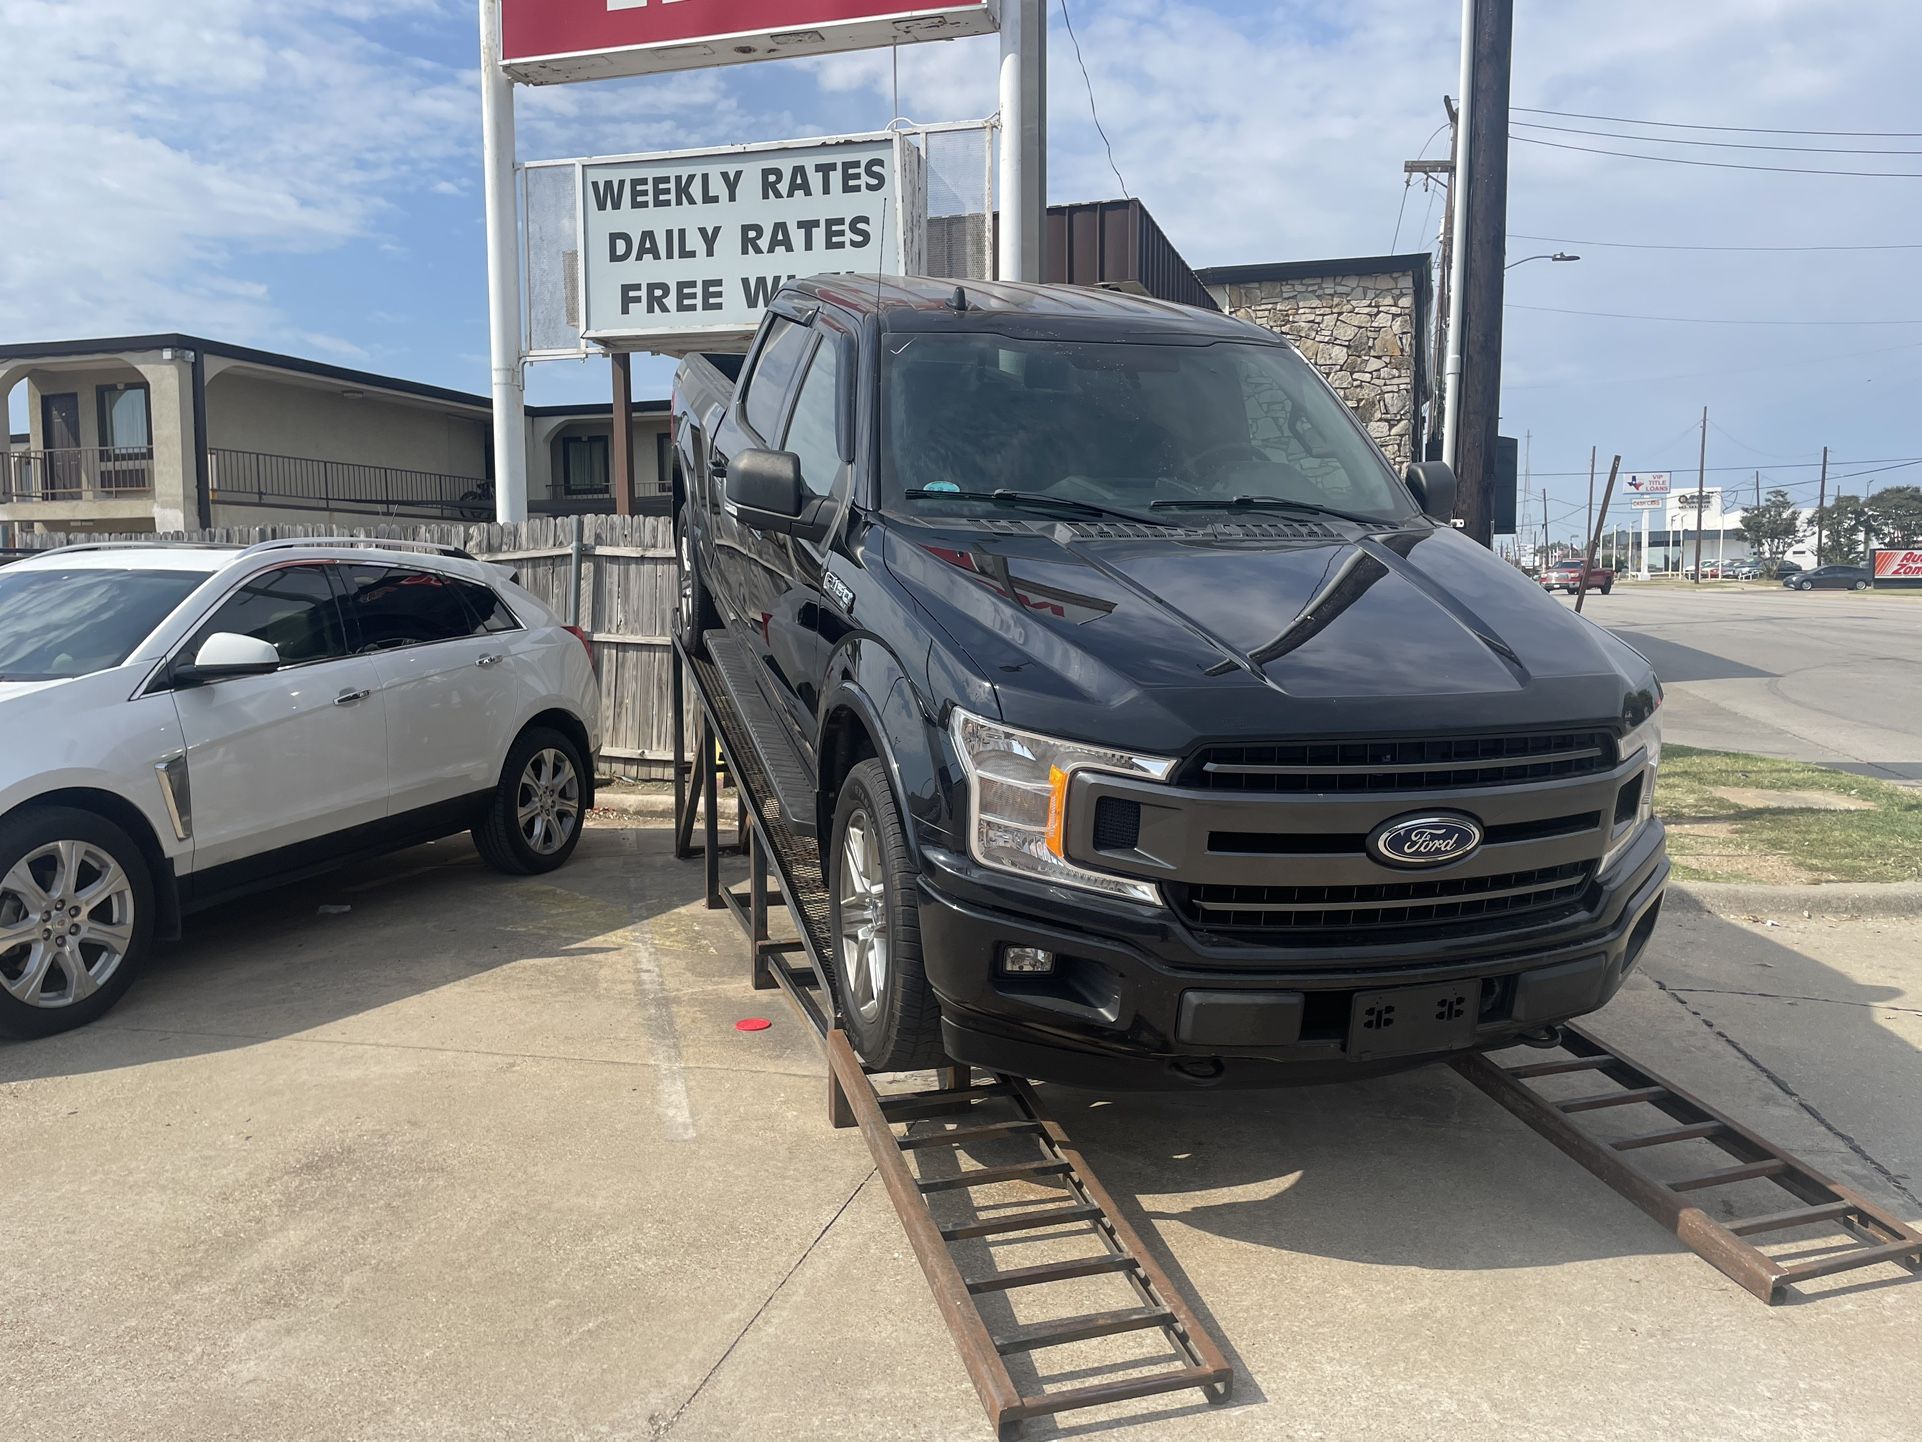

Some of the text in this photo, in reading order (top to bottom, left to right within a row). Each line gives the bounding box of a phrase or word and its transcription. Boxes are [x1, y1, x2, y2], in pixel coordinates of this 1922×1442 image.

[590, 157, 886, 211] WEEKLY RATES
[608, 215, 871, 263] DAILY RATES
[620, 278, 723, 315] FREE
[1891, 563, 1922, 574] Zon
[1900, 552, 1922, 562] Au
[1403, 828, 1459, 854] Ford
